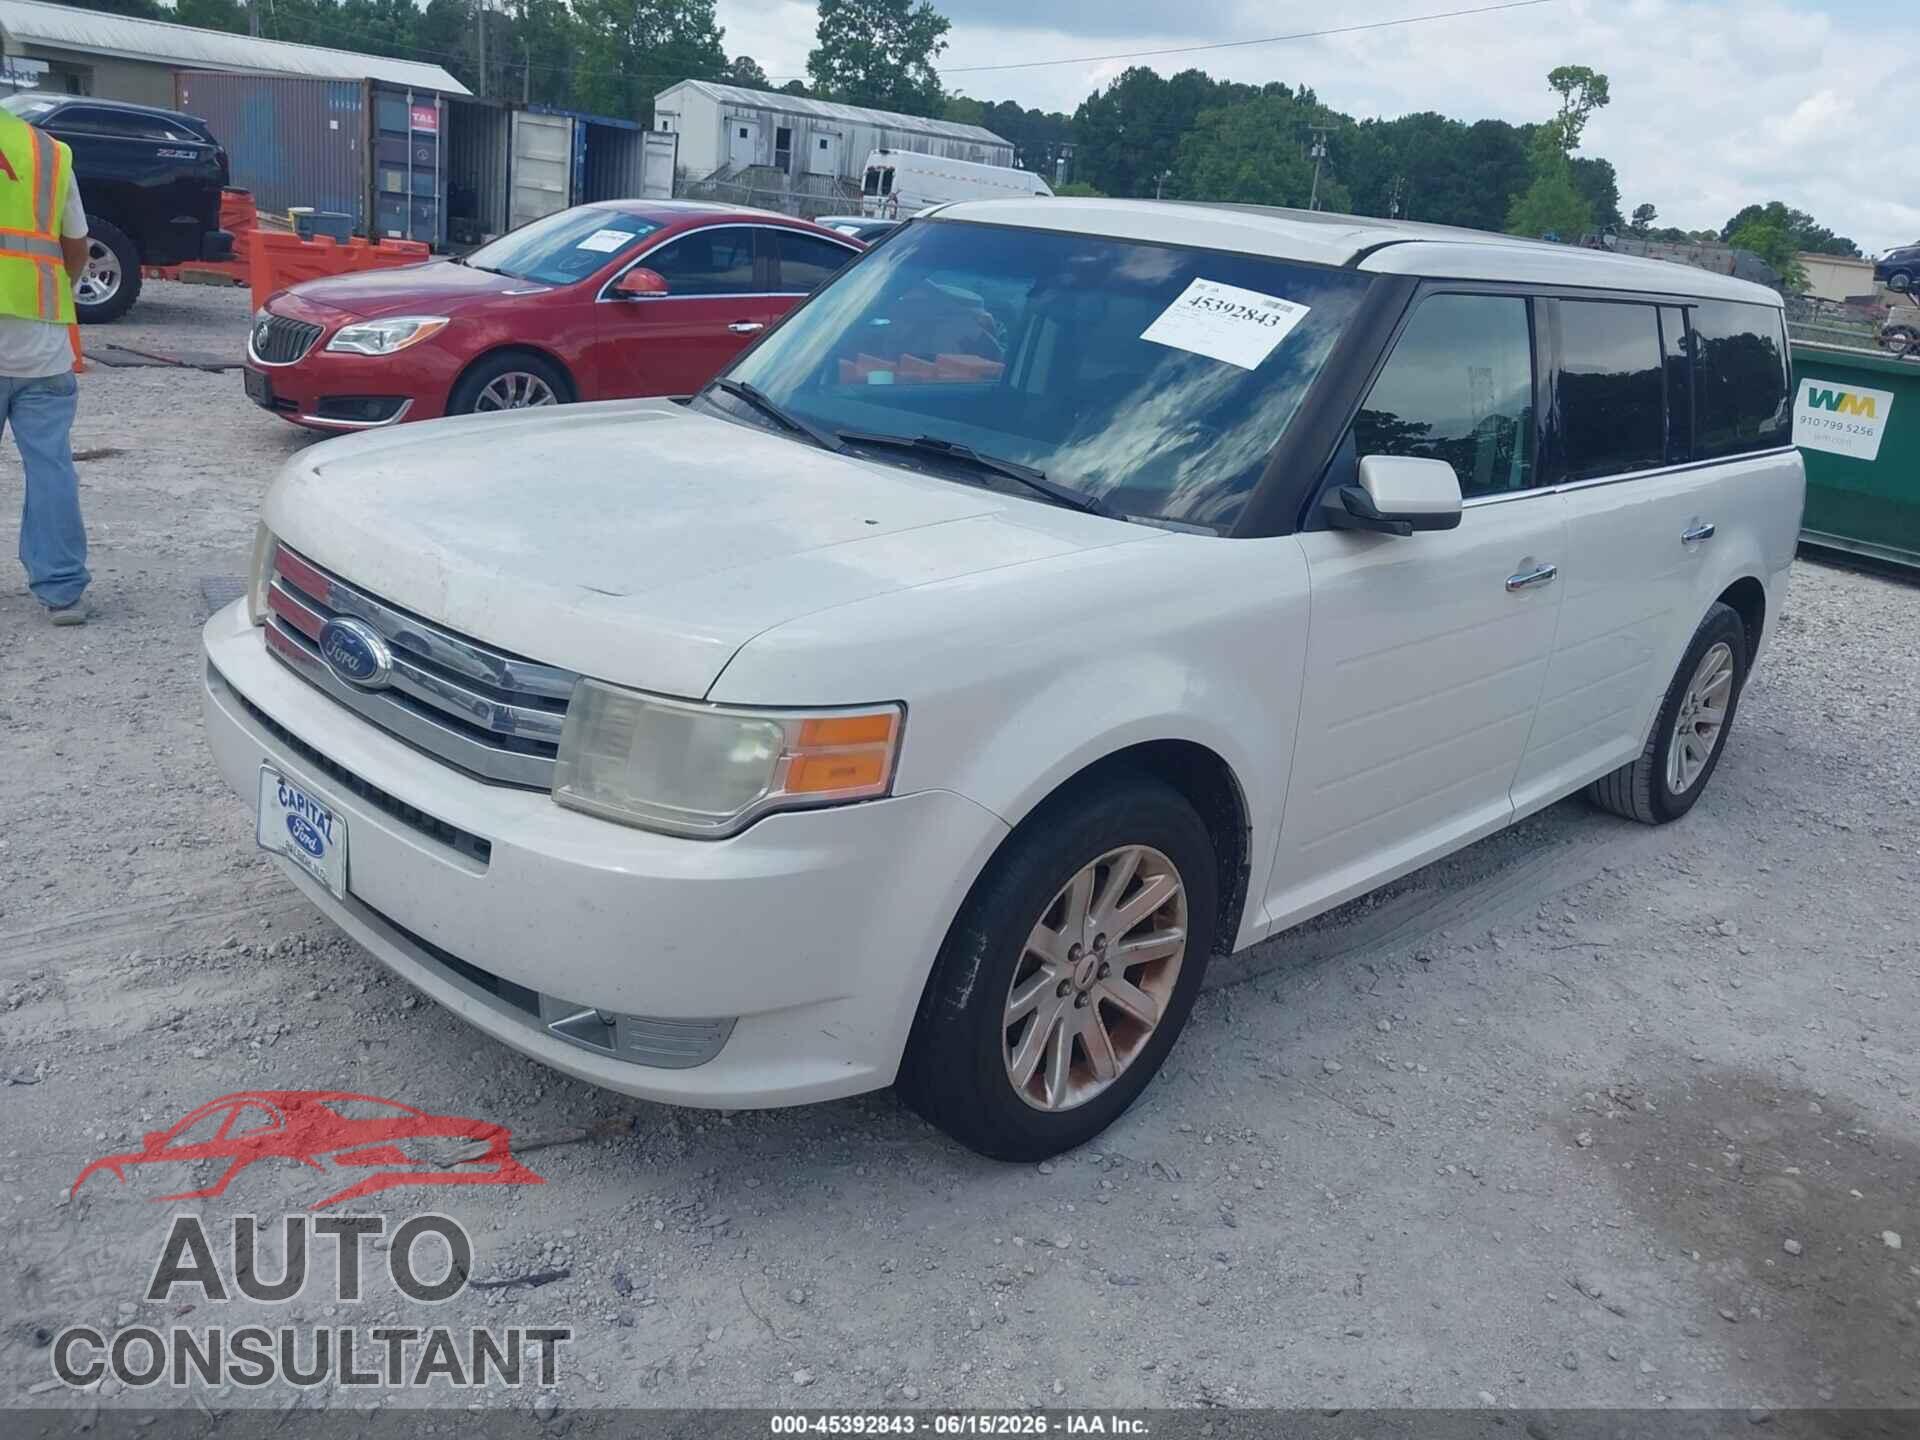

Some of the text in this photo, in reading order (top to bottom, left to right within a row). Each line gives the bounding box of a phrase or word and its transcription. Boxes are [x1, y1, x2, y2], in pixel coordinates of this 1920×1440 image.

[411, 112, 435, 124] TAL
[1188, 295, 1281, 328] 45392843
[1808, 387, 1875, 418] WM
[1800, 415, 1874, 437] 910 799 5256
[325, 629, 361, 672] Ford
[278, 784, 334, 846] CAPITAL
[292, 817, 318, 852] Ford
